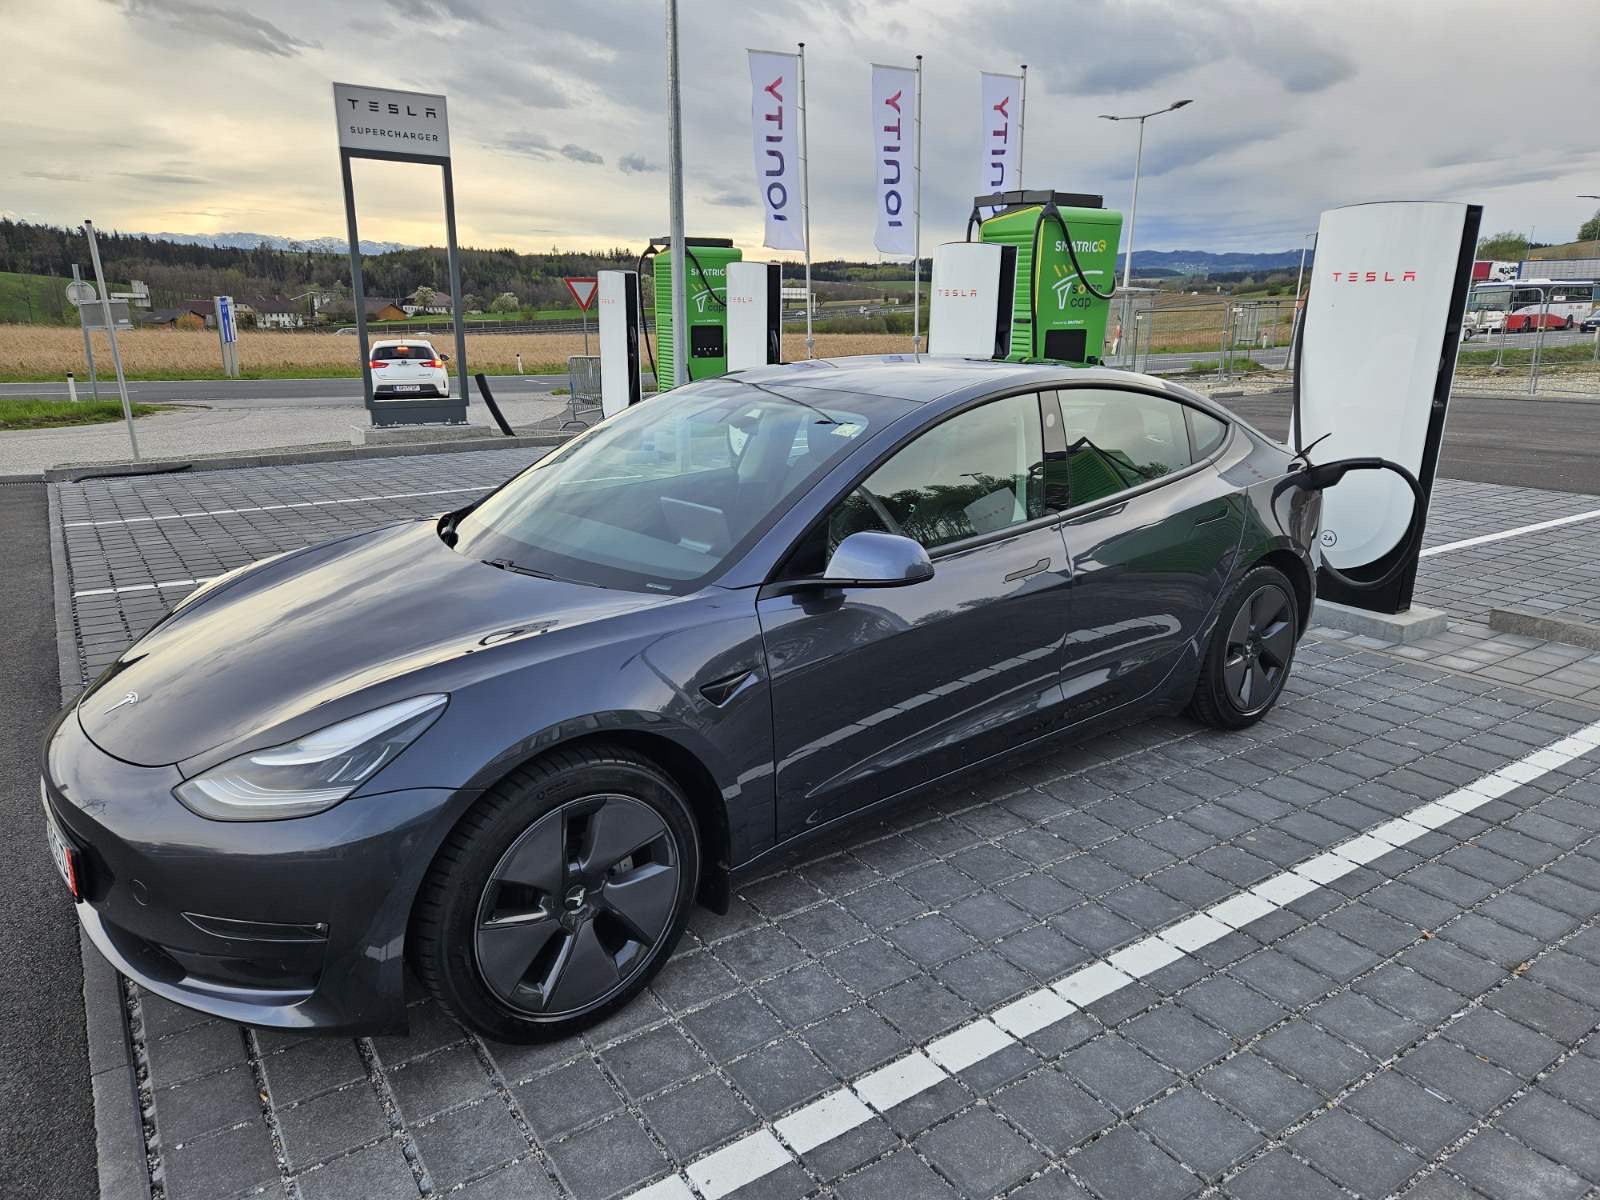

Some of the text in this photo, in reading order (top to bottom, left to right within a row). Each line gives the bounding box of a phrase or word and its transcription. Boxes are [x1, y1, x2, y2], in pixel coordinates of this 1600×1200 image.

[347, 99, 437, 118] TESLA
[350, 126, 439, 141] SUPERCHARGER
[1333, 271, 1416, 282] TESLA
[938, 289, 977, 297] TESLA
[1070, 298, 1092, 309] cap
